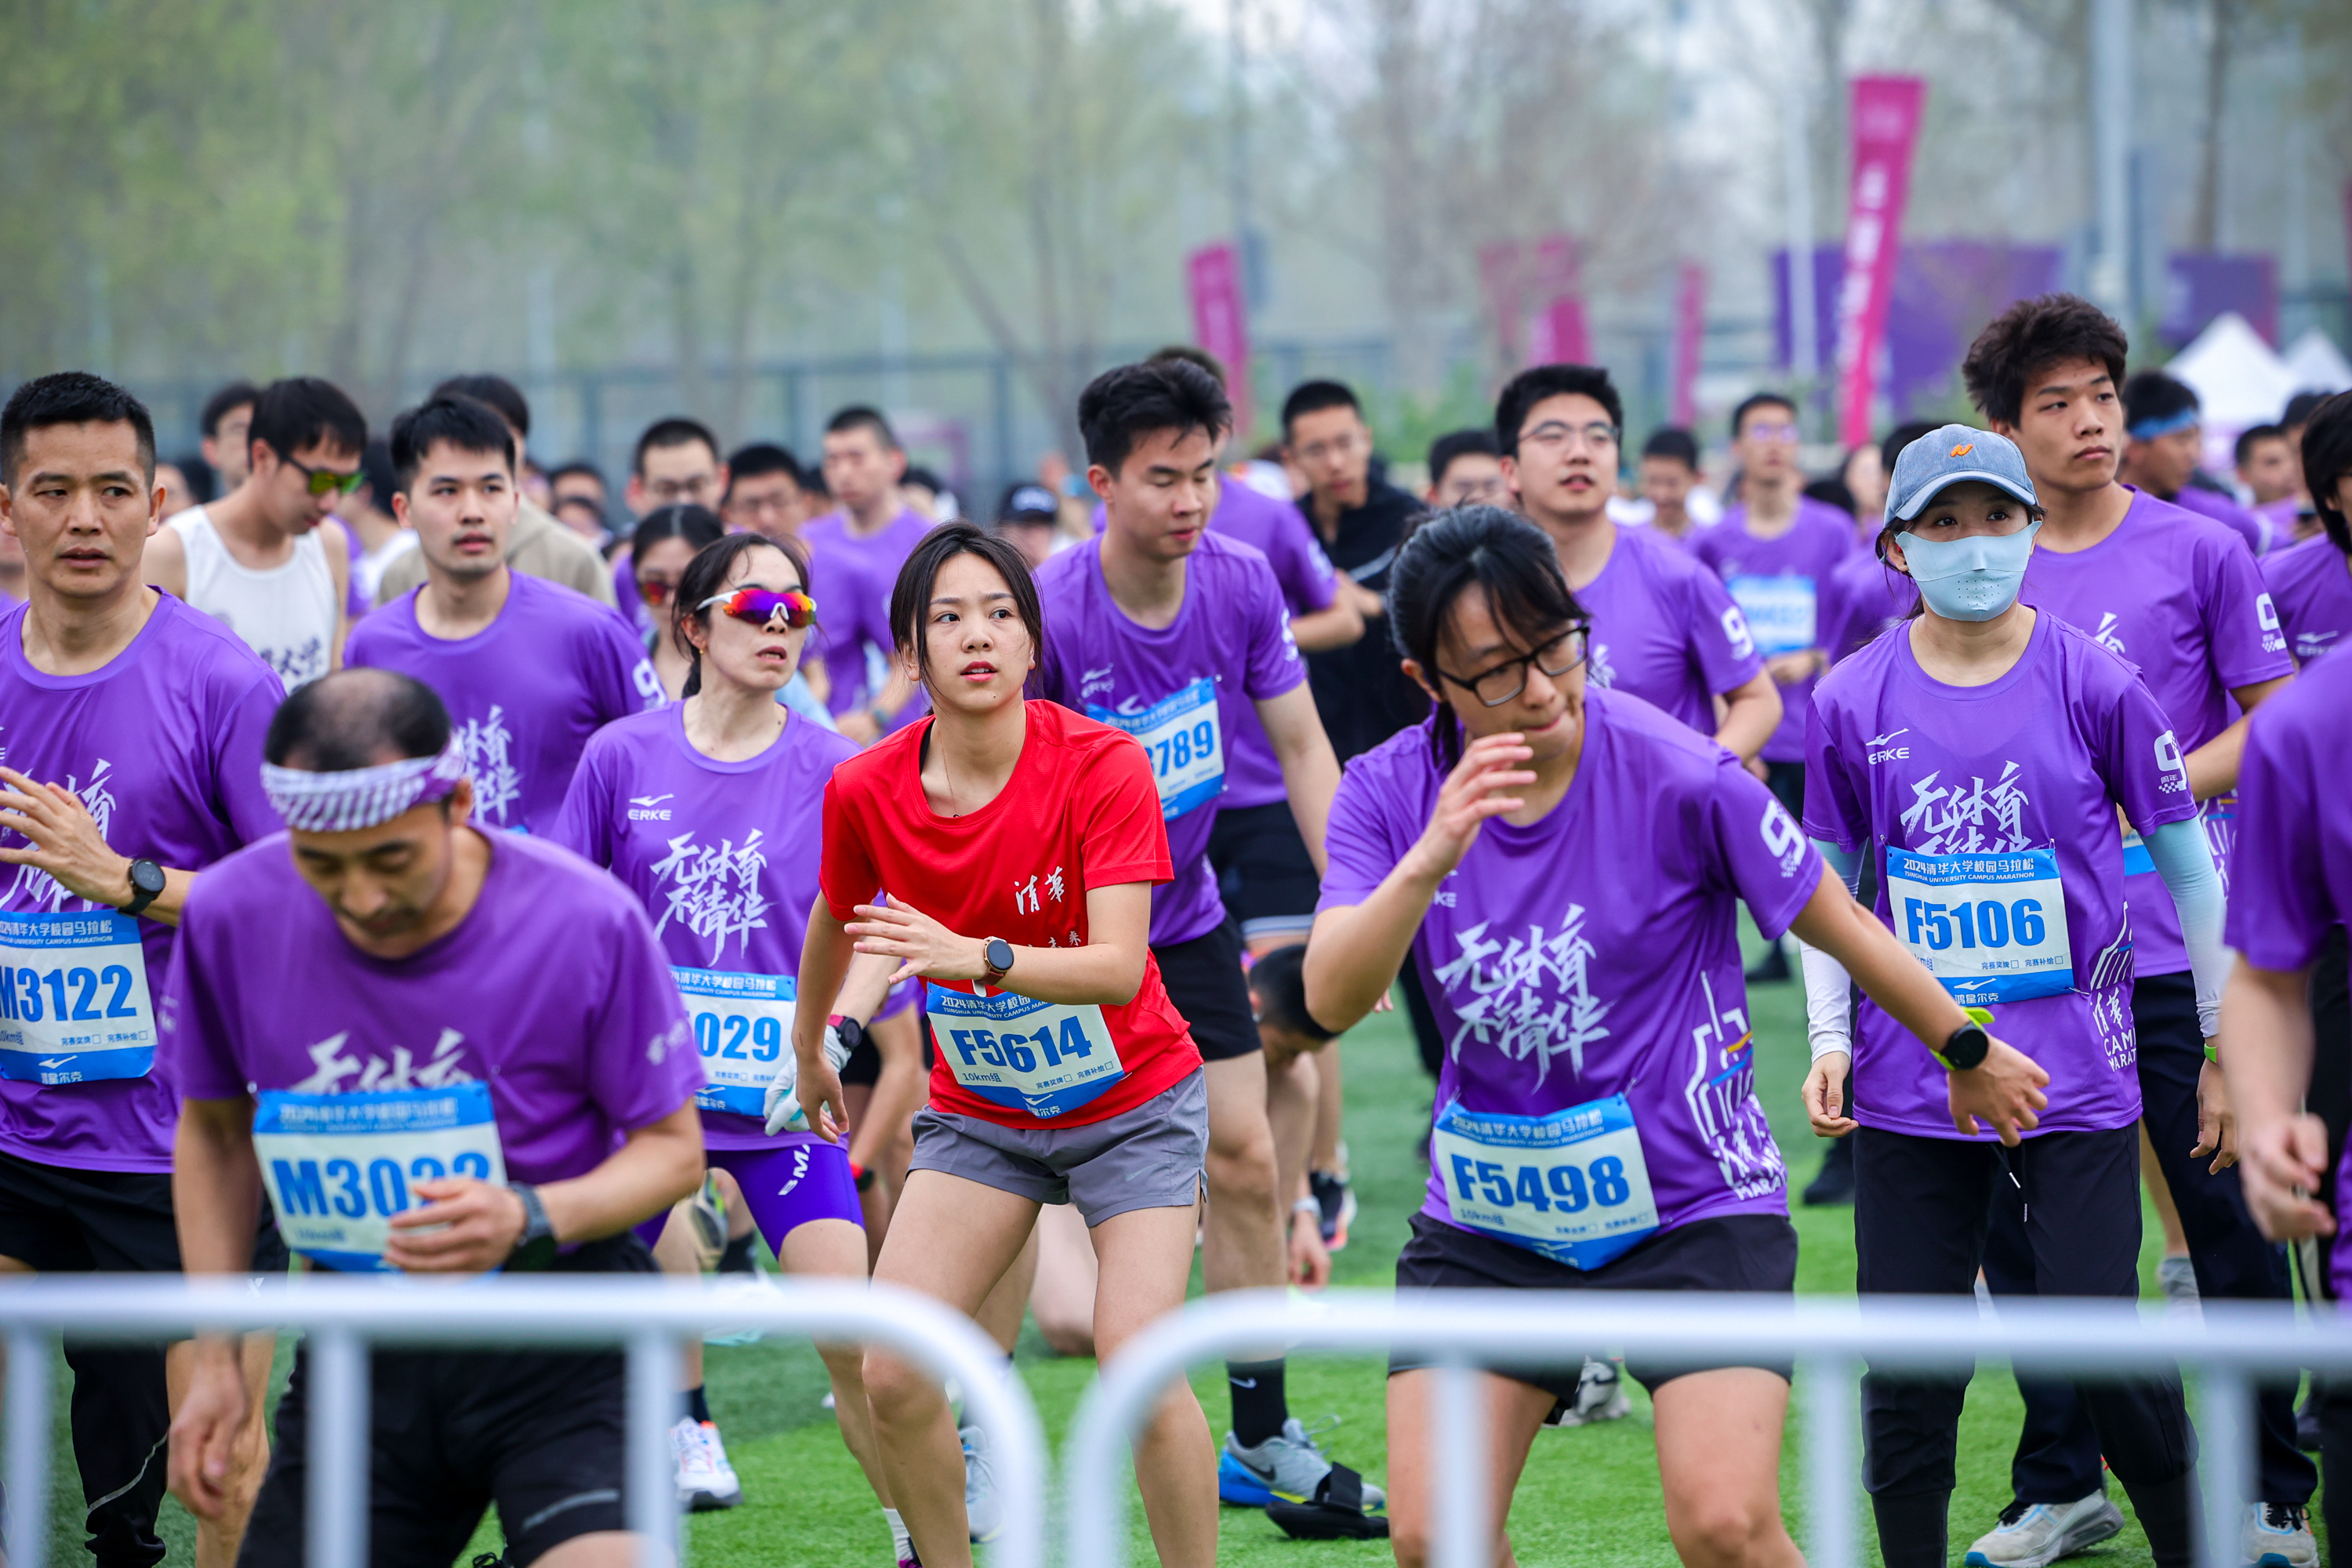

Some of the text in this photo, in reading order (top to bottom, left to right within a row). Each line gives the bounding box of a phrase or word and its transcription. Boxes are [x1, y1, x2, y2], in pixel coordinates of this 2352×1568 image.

[1868, 747, 1910, 764] ERKE
[628, 809, 671, 821] ERKE
[1900, 760, 2029, 844] 无体育
[649, 828, 768, 895] 无体育
[1903, 858, 2034, 876] 2024清华大学校园马拉松
[1904, 870, 1928, 881] TSINGHUA
[1929, 874, 1966, 883] UNIVERSITY
[1996, 872, 2034, 880] MARATHON
[1904, 897, 2045, 950] F5106
[1433, 902, 1596, 1000] 无体育
[1981, 957, 2054, 970] 完赛奖牌 完赛补给
[0, 964, 137, 1022] M3122
[1955, 992, 1999, 1004] 鸿星尔克
[943, 1007, 971, 1015] TSINGHUA
[972, 1010, 1003, 1018] UNIVERSITY
[1004, 1005, 1030, 1018] CAMPUS
[687, 1011, 781, 1062] 029
[949, 1015, 1093, 1073] F5614
[2104, 1028, 2136, 1057] CAM
[963, 1064, 1105, 1090] 10km组 完赛奖牌 完赛补给
[1451, 1154, 1630, 1213] F5498
